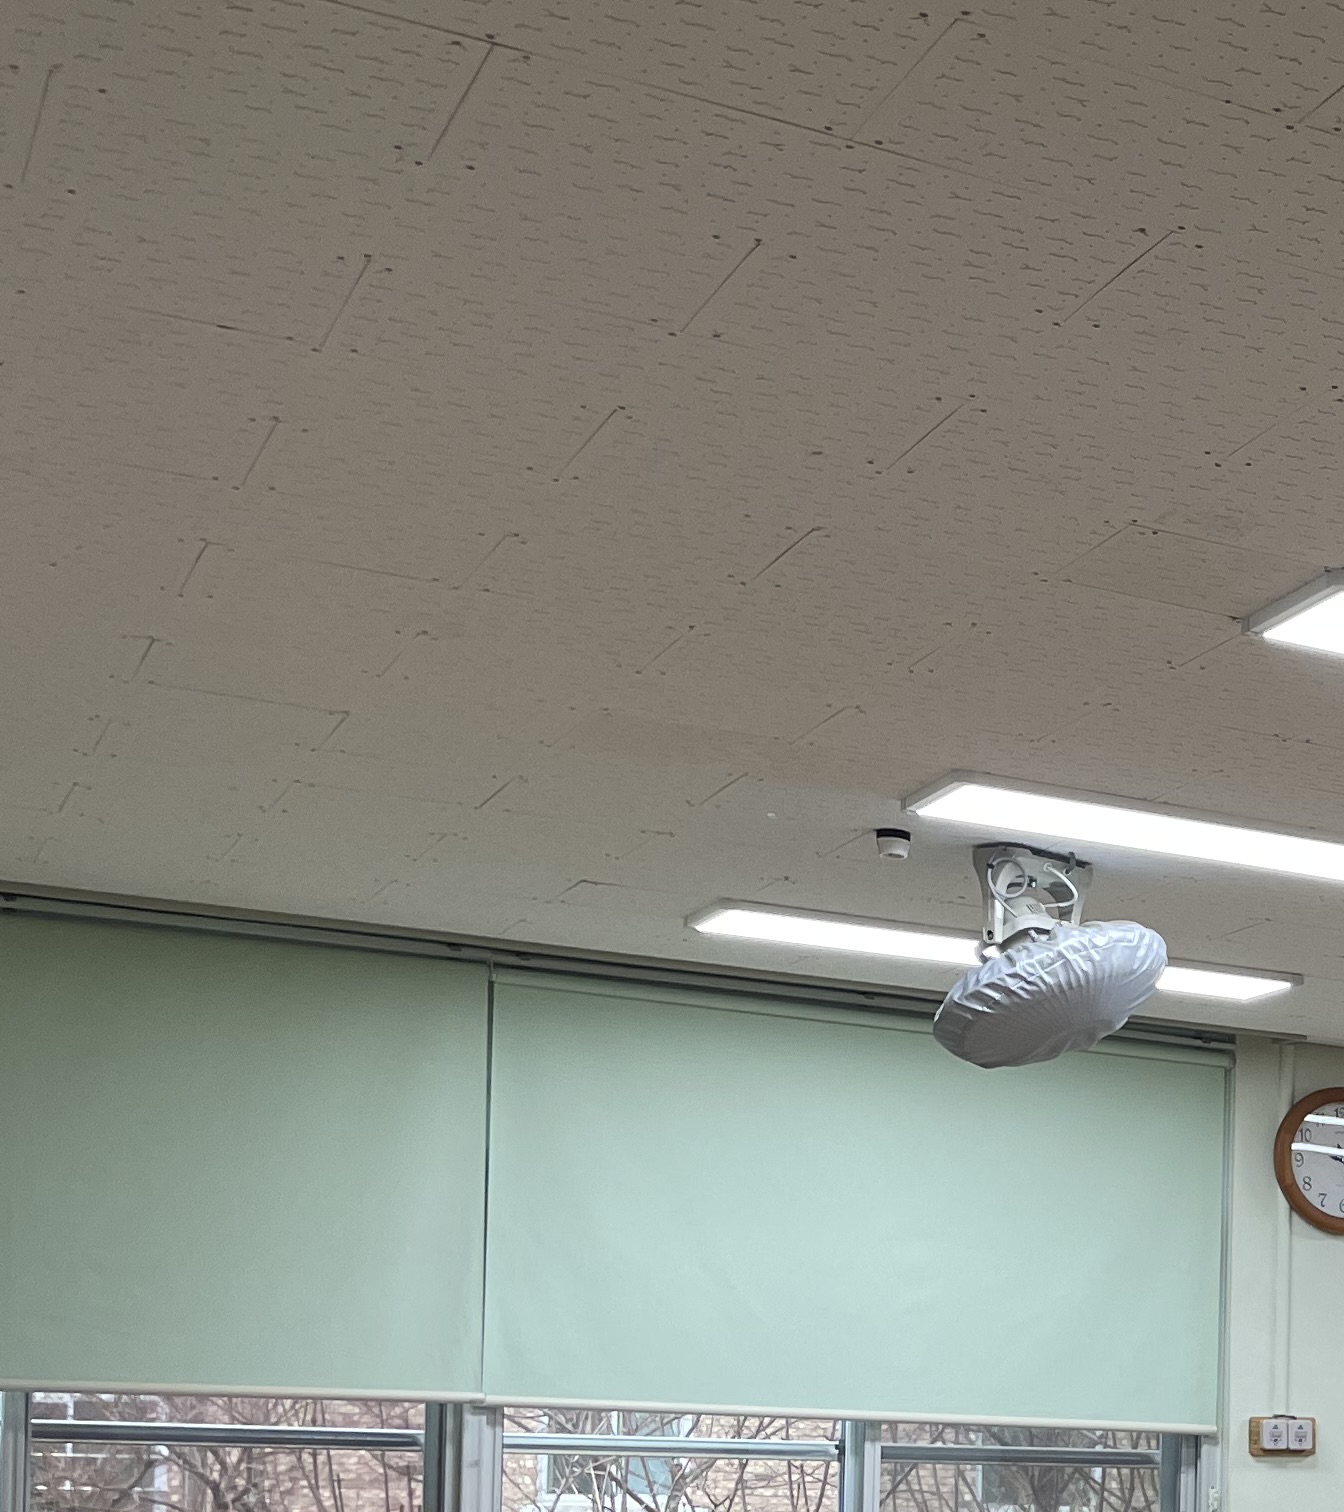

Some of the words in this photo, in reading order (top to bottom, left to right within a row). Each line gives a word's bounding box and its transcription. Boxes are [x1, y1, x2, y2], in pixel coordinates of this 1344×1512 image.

[1300, 1128, 1312, 1142] 10
[1295, 1152, 1304, 1168] 9
[1302, 1176, 1312, 1191] 8
[1318, 1193, 1327, 1207] 7
